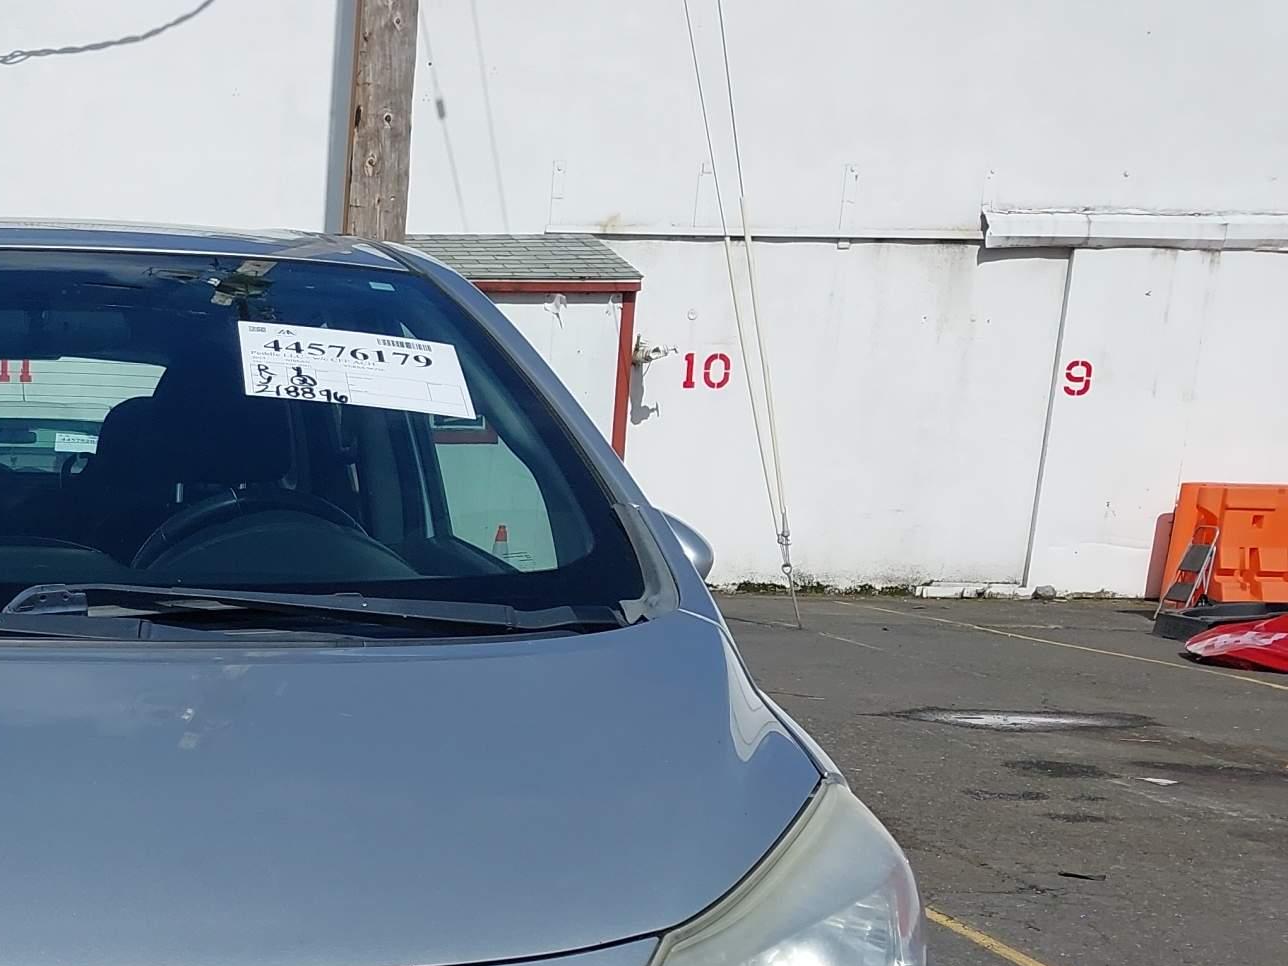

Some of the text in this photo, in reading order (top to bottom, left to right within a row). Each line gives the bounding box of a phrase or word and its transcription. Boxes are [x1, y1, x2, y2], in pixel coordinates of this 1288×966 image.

[264, 339, 432, 368] 44576179
[683, 353, 730, 388] 10
[1064, 361, 1092, 396] 9
